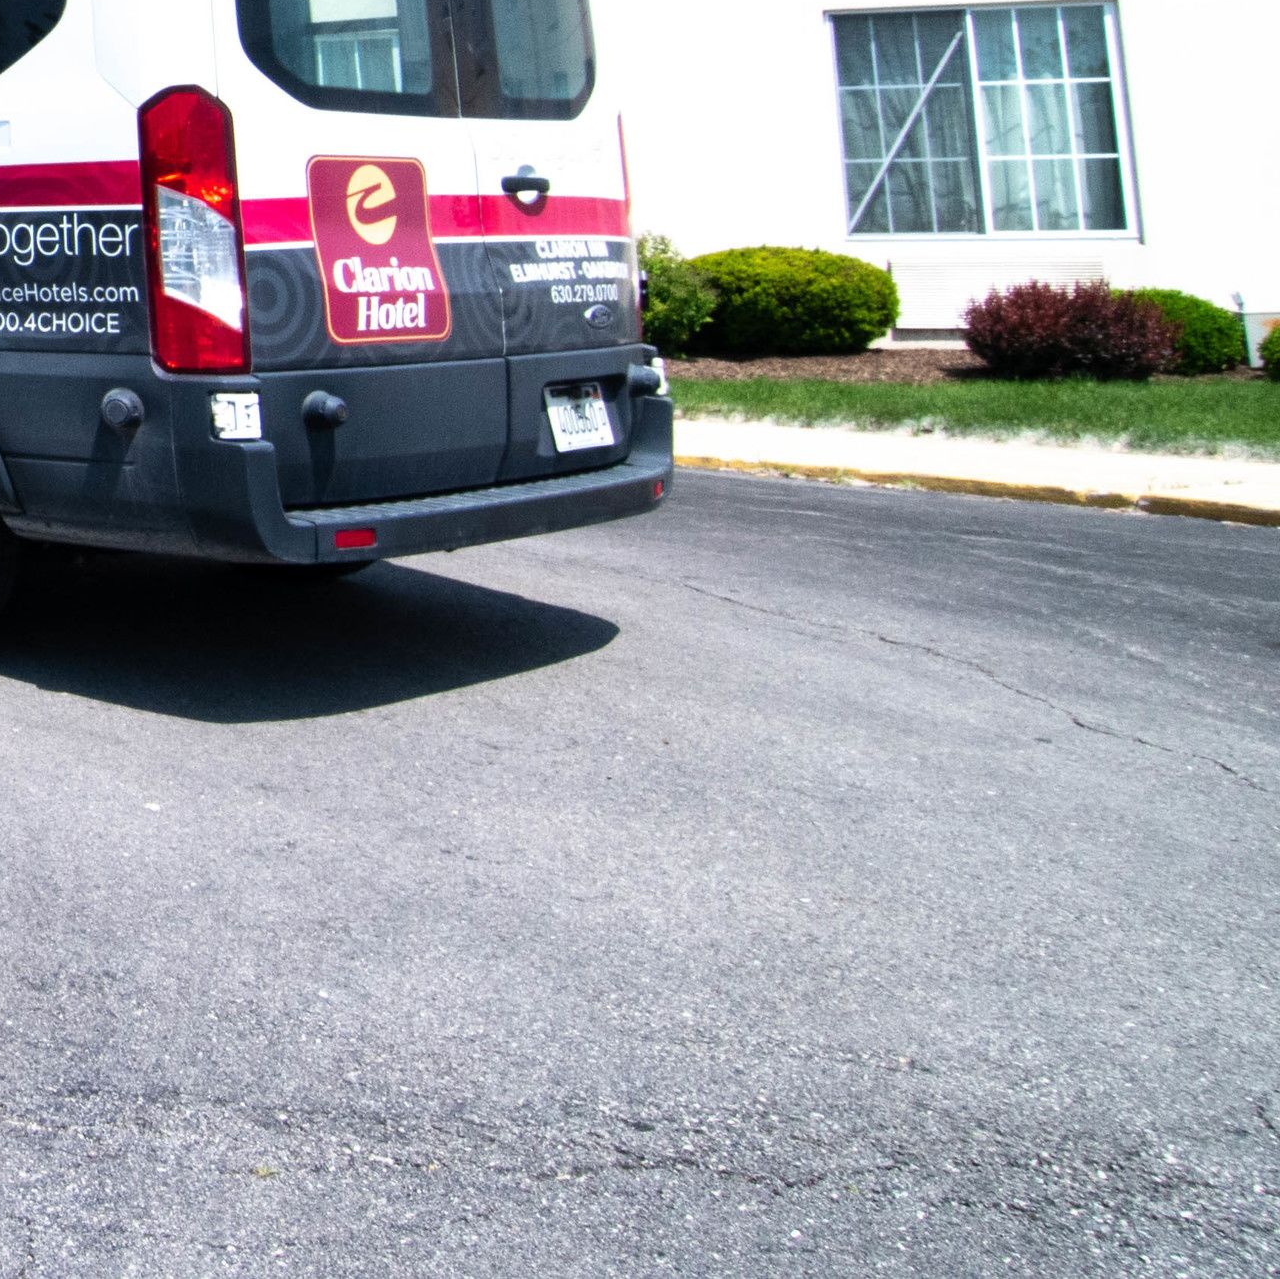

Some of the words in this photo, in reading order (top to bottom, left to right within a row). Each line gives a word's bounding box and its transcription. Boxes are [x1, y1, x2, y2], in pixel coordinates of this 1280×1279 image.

[333, 256, 436, 294] Clarion
[550, 282, 619, 304] 630.279.0700
[356, 292, 427, 332] Hotel
